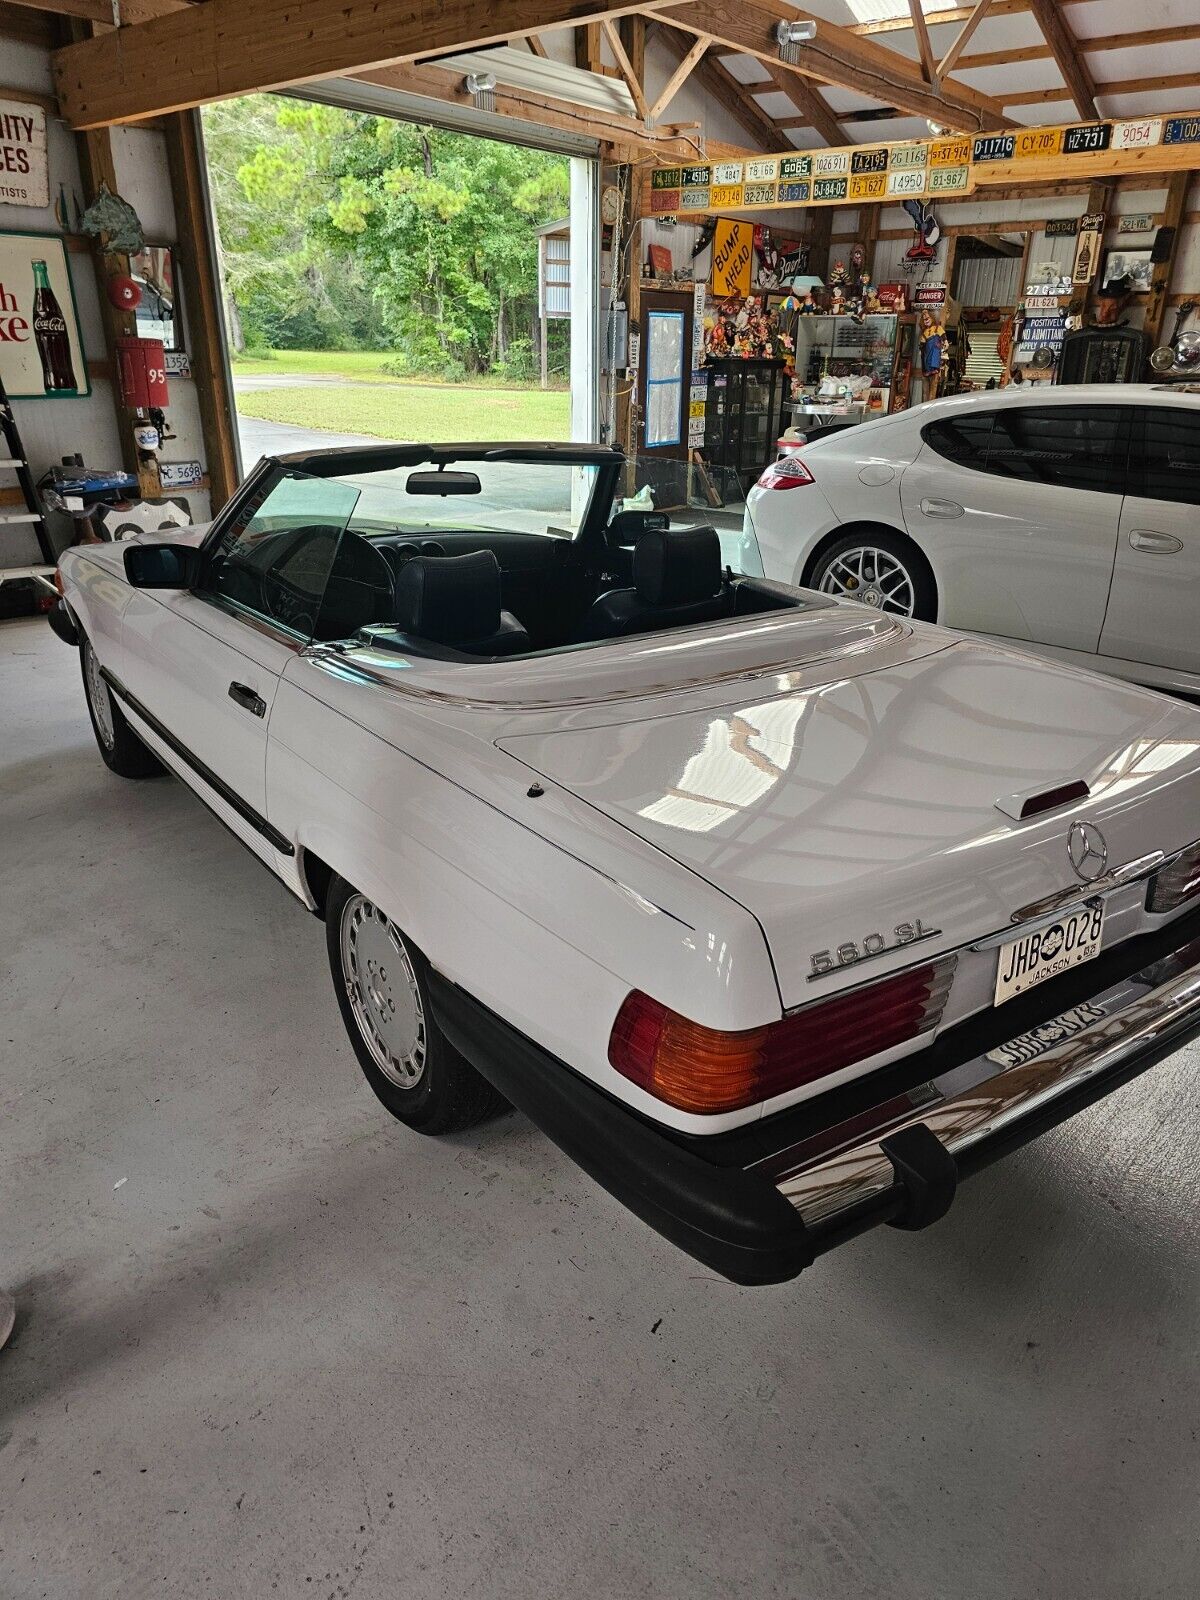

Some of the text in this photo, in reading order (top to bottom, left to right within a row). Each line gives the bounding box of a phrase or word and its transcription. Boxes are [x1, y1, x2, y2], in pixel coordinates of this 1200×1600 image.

[1123, 126, 1150, 142] 9054
[834, 157, 847, 169] 911
[865, 153, 885, 167] 2195
[893, 173, 923, 190] 14950
[714, 224, 740, 273] BUMP
[725, 245, 750, 292] AHEAD
[919, 292, 942, 300] DANGER
[34, 317, 65, 332] Coca-Cola
[1030, 319, 1064, 327] POSITIVELY
[149, 369, 165, 384] 95
[177, 466, 200, 479] 5698
[809, 919, 935, 975] 560 SL
[1003, 908, 1103, 983] JHB 028
[1029, 955, 1071, 984] JACKSON
